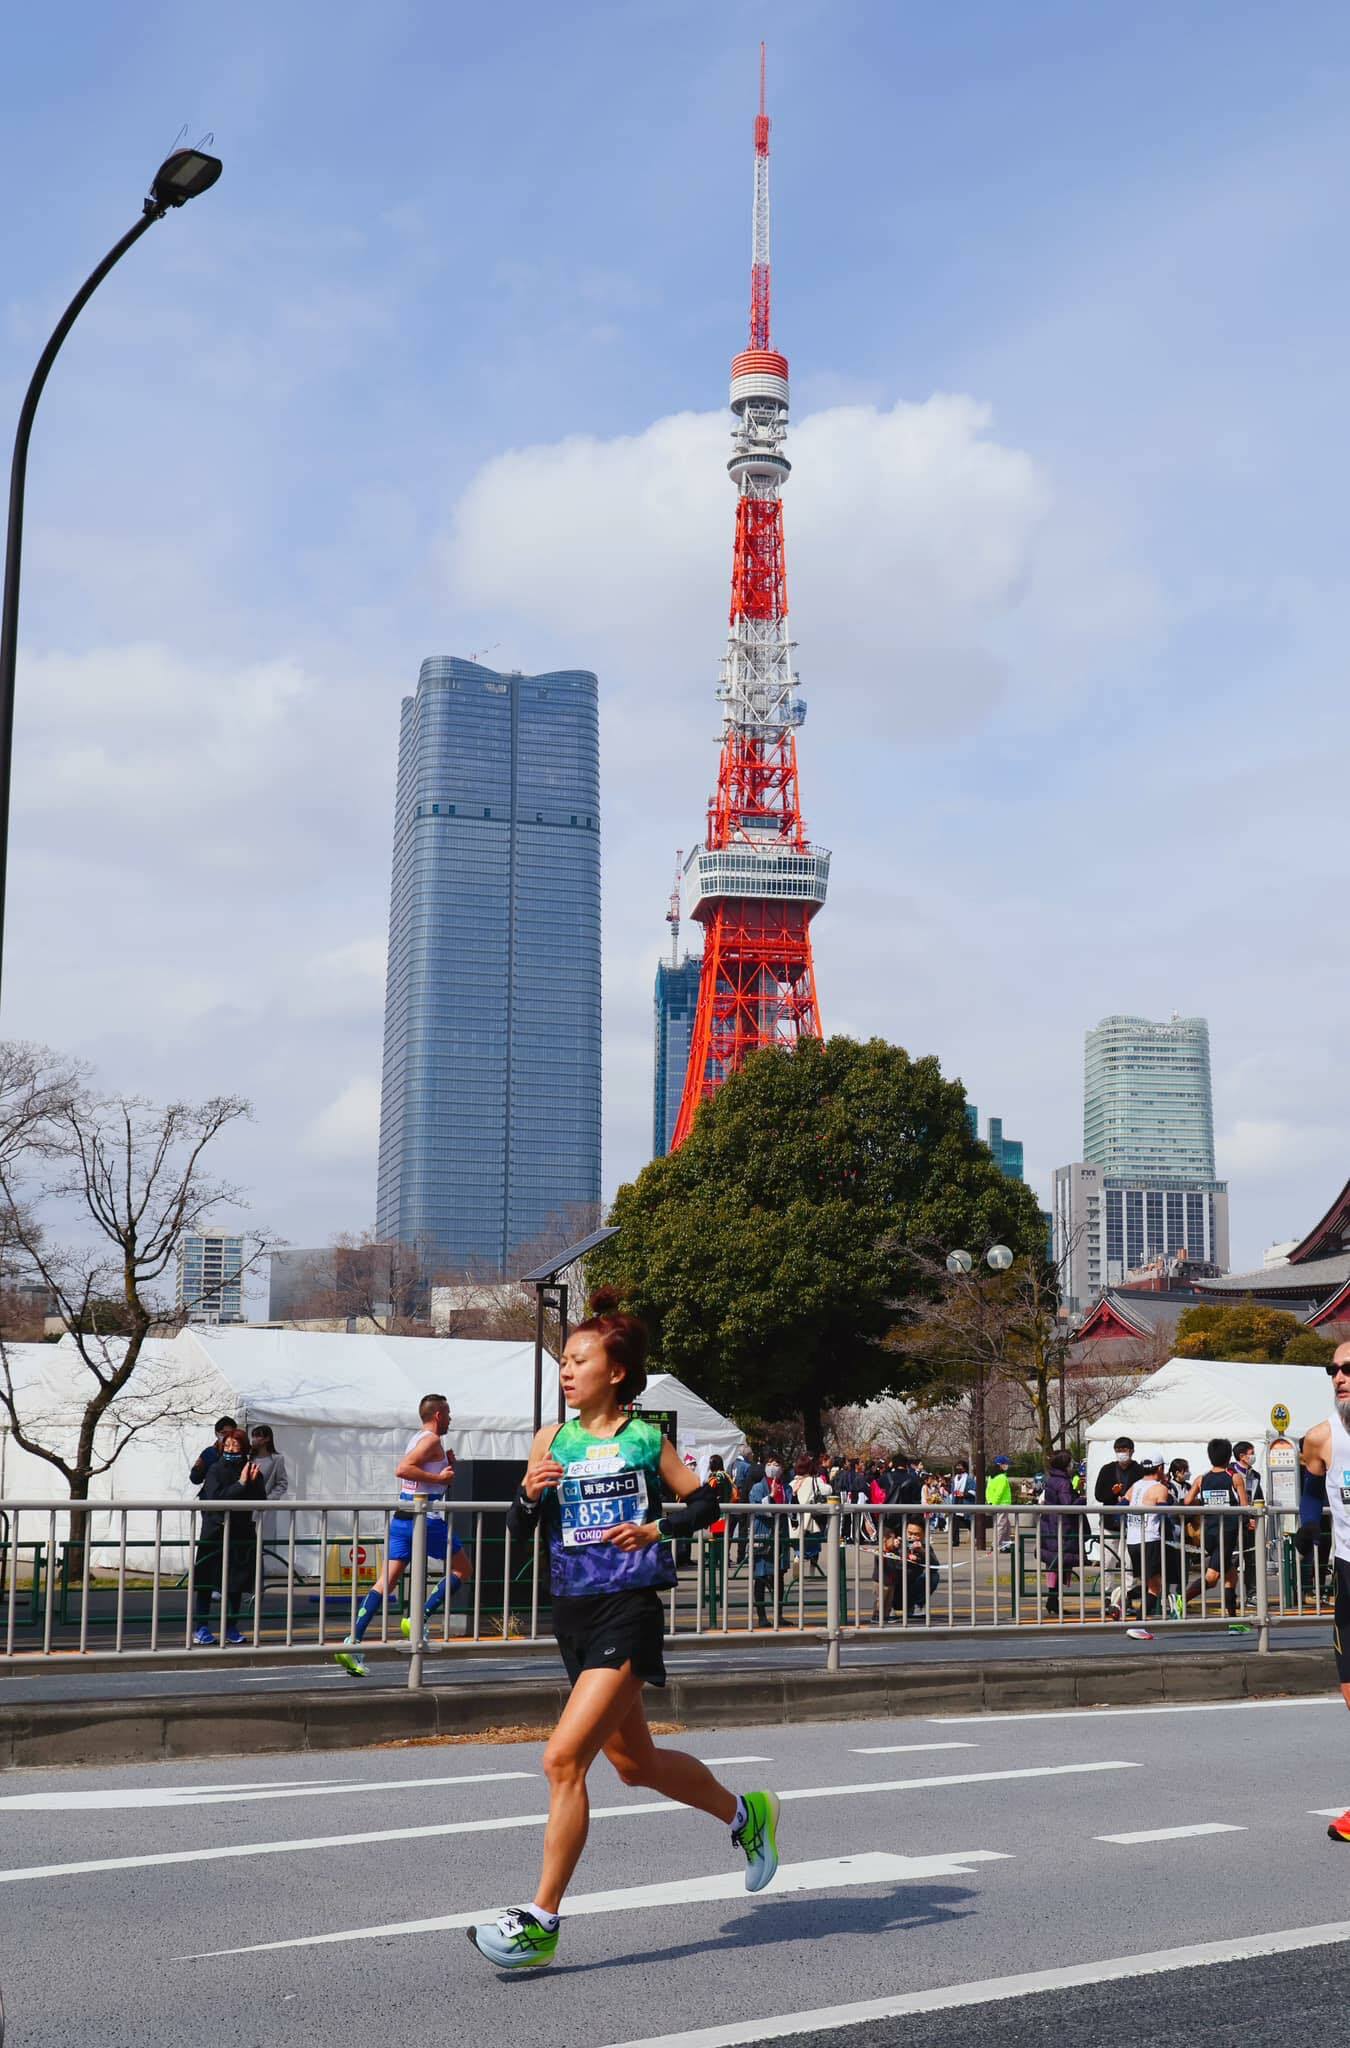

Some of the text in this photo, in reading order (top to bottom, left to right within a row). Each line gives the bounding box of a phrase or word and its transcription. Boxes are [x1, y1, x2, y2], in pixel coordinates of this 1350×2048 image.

[584, 1480, 634, 1495] 東京メトロ
[565, 1508, 573, 1518] A
[579, 1500, 624, 1525] 8551
